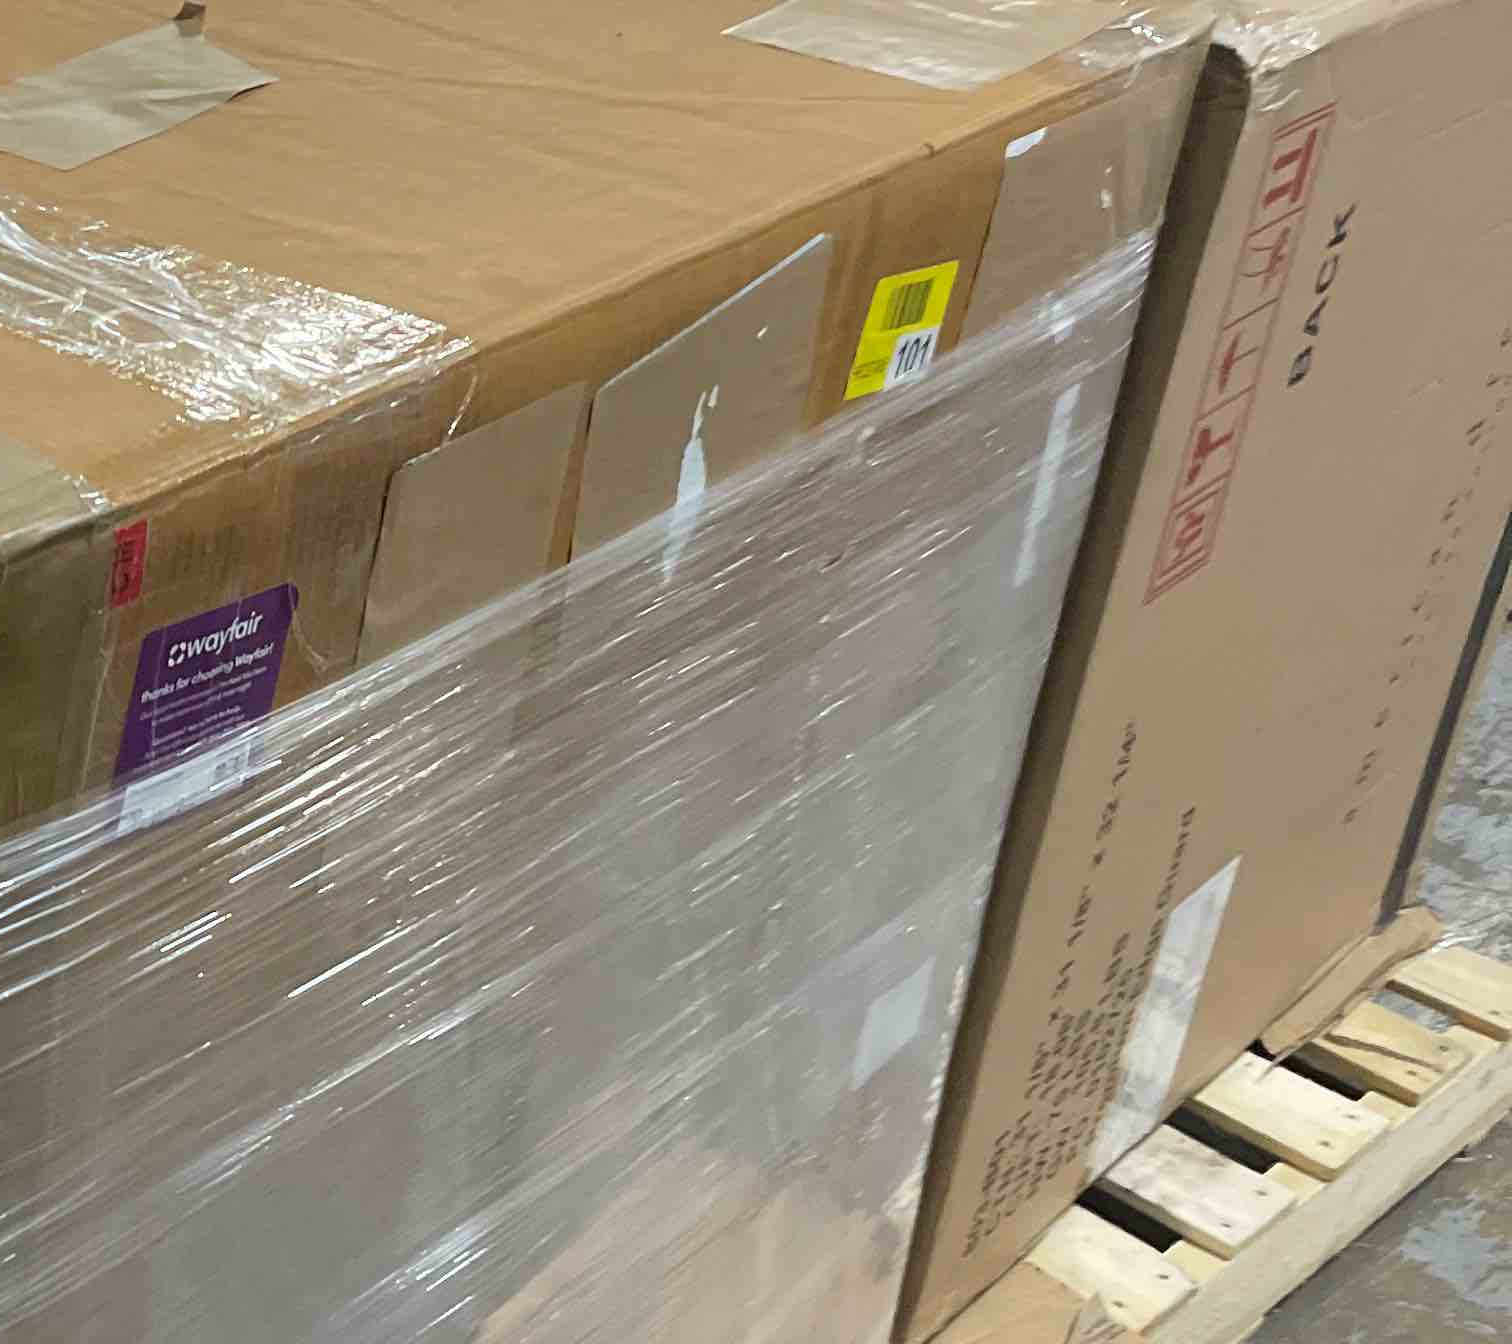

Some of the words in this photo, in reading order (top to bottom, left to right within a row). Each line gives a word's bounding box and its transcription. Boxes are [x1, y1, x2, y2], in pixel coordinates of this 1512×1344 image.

[1287, 202, 1357, 388] BACK
[894, 333, 933, 379] 101
[187, 611, 264, 658] wayfair
